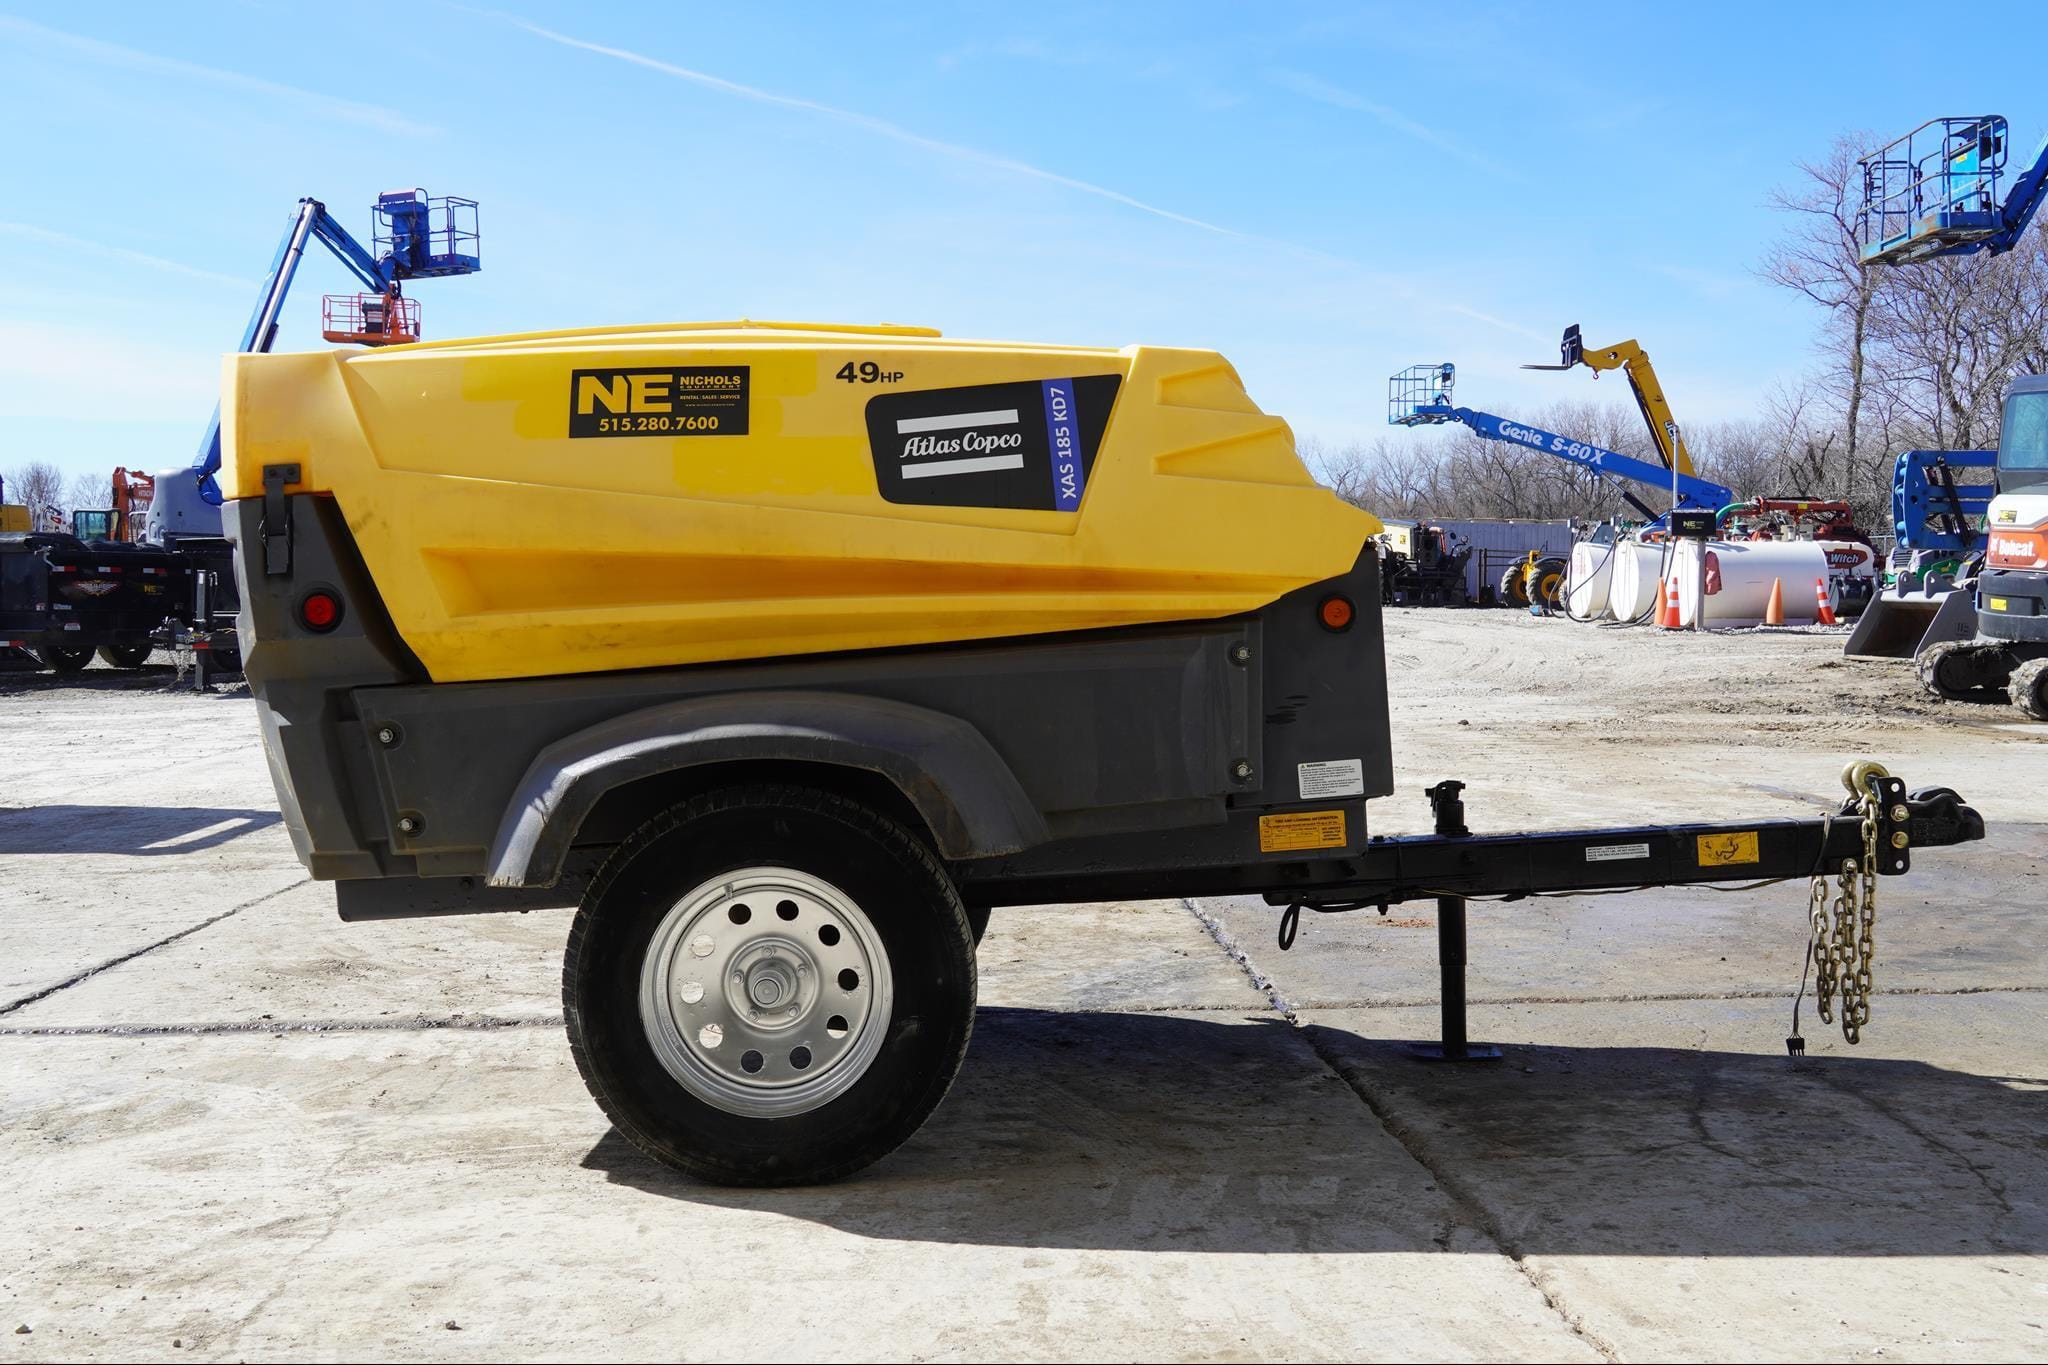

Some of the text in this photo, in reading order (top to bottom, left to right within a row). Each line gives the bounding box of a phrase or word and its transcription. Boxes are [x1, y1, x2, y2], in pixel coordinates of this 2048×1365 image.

[679, 375, 741, 385] NICHOLS
[578, 374, 673, 414] NE
[599, 416, 719, 432] 515.280.7600
[1499, 420, 1543, 446] Genie
[899, 431, 1022, 458] Atlas Copco
[1050, 387, 1077, 499] XAS 185 KD7
[1830, 552, 1859, 564] Witch
